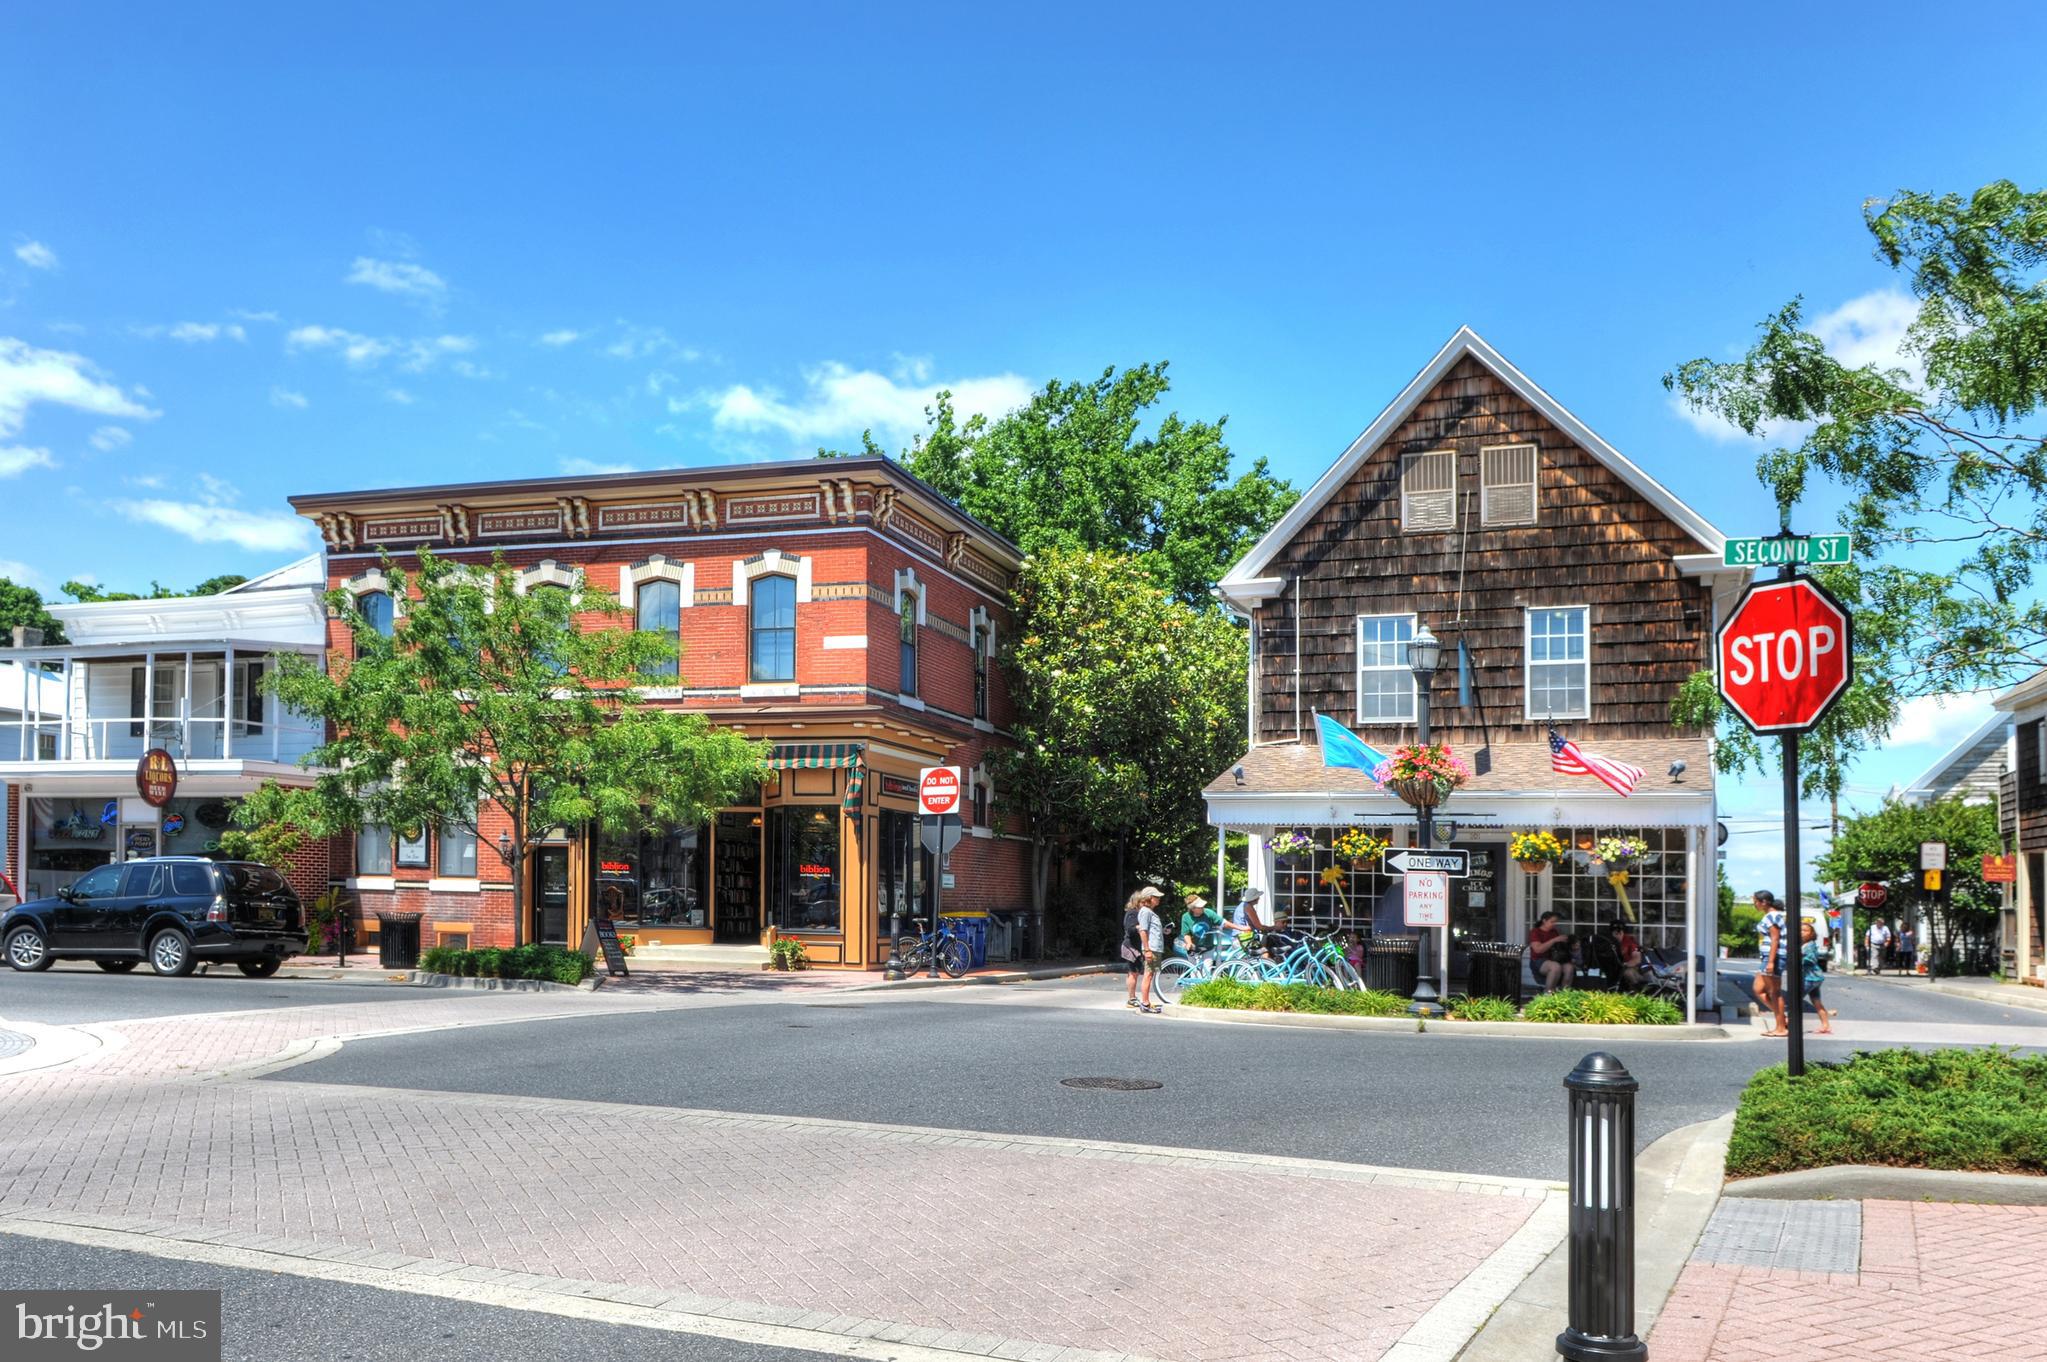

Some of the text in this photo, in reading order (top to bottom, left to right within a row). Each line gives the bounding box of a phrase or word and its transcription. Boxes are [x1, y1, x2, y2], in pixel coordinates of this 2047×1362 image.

[1734, 538, 1839, 563] SECOND ST
[1729, 624, 1836, 686] STOP
[926, 776, 954, 785] DO NOT
[928, 797, 950, 805] ENTER
[601, 861, 630, 870] biblion
[1408, 857, 1431, 868] ONE
[1435, 858, 1459, 868] WAY
[800, 864, 831, 873] biblion
[1418, 879, 1433, 887] NO
[1408, 891, 1443, 899] PARKING
[1860, 889, 1885, 900] STOP
